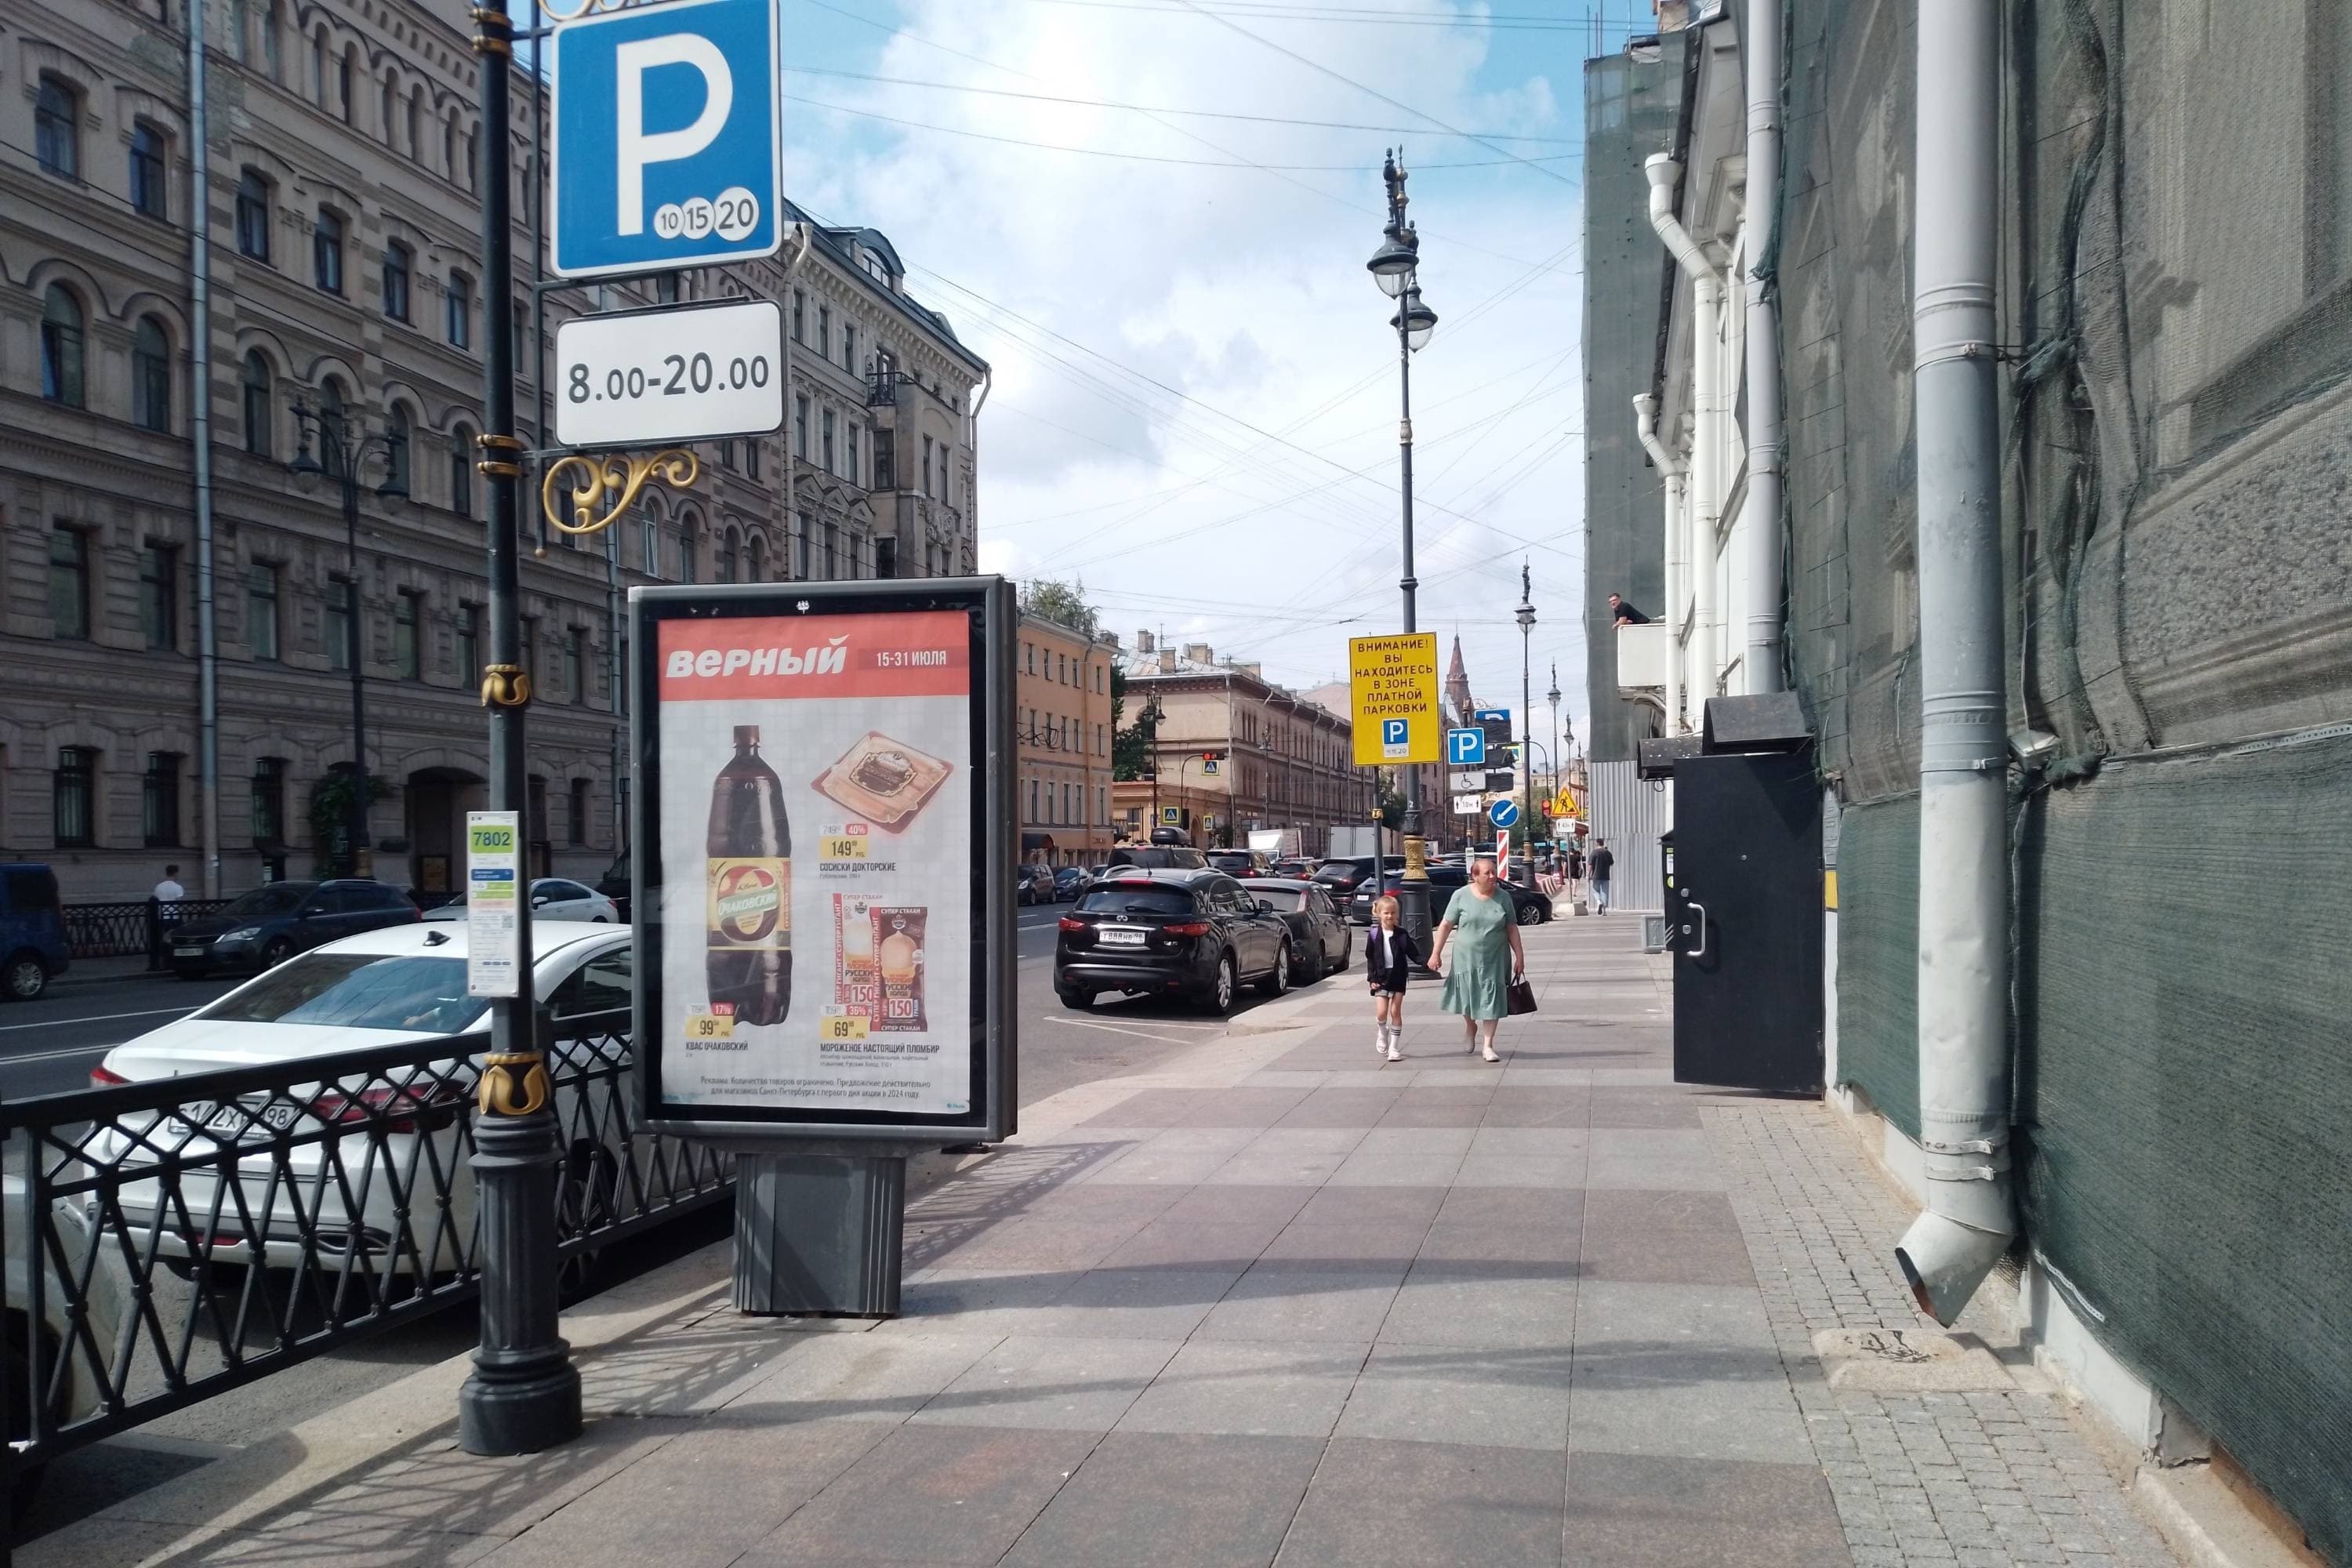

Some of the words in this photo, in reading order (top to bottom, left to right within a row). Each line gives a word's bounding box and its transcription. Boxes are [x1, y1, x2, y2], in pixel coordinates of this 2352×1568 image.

[617, 32, 733, 235] P
[661, 212, 678, 230] 10
[687, 206, 709, 230] 15
[719, 198, 754, 230] 20
[568, 352, 769, 404] 8.00-20.00
[1358, 639, 1428, 652] ВНИМАНИЕ!
[876, 652, 909, 667] 15-31
[912, 650, 947, 666] ИЮЛЯ
[1385, 654, 1402, 663] ВЫ
[1355, 665, 1432, 677] НАХОДИТЕСЬ
[1374, 681, 1380, 689] В
[1385, 678, 1415, 688] ЗОНЕ
[1367, 688, 1422, 702] ПЛАТНОЙ
[1363, 703, 1427, 715] ПАРКОВКИ
[1389, 721, 1404, 742] P
[1458, 733, 1478, 760] P
[474, 832, 511, 846] 7802
[832, 840, 852, 856] 149
[819, 863, 851, 872] СОСИСКИ
[852, 862, 896, 872] ДОКТОРСКИЕ
[853, 985, 873, 1003] 150
[890, 1000, 912, 1017] 150
[834, 1022, 848, 1036] 69
[685, 1042, 703, 1051] КВАС
[704, 1040, 748, 1051] ОЧАКОВСКИЙ
[820, 1043, 862, 1052] МОРОЖЕНОЕ
[863, 1043, 905, 1054] НАСТОЯЩИЙ
[906, 1044, 940, 1054] ПЛОМБИР
[731, 1076, 768, 1085] Количество
[837, 1078, 881, 1088] Предложение
[882, 1079, 931, 1088] действительно
[759, 1087, 815, 1097] Санкт-Петербурга
[821, 1088, 847, 1098] первого
[887, 1089, 904, 1098] 2024
[267, 1107, 288, 1125] 98
